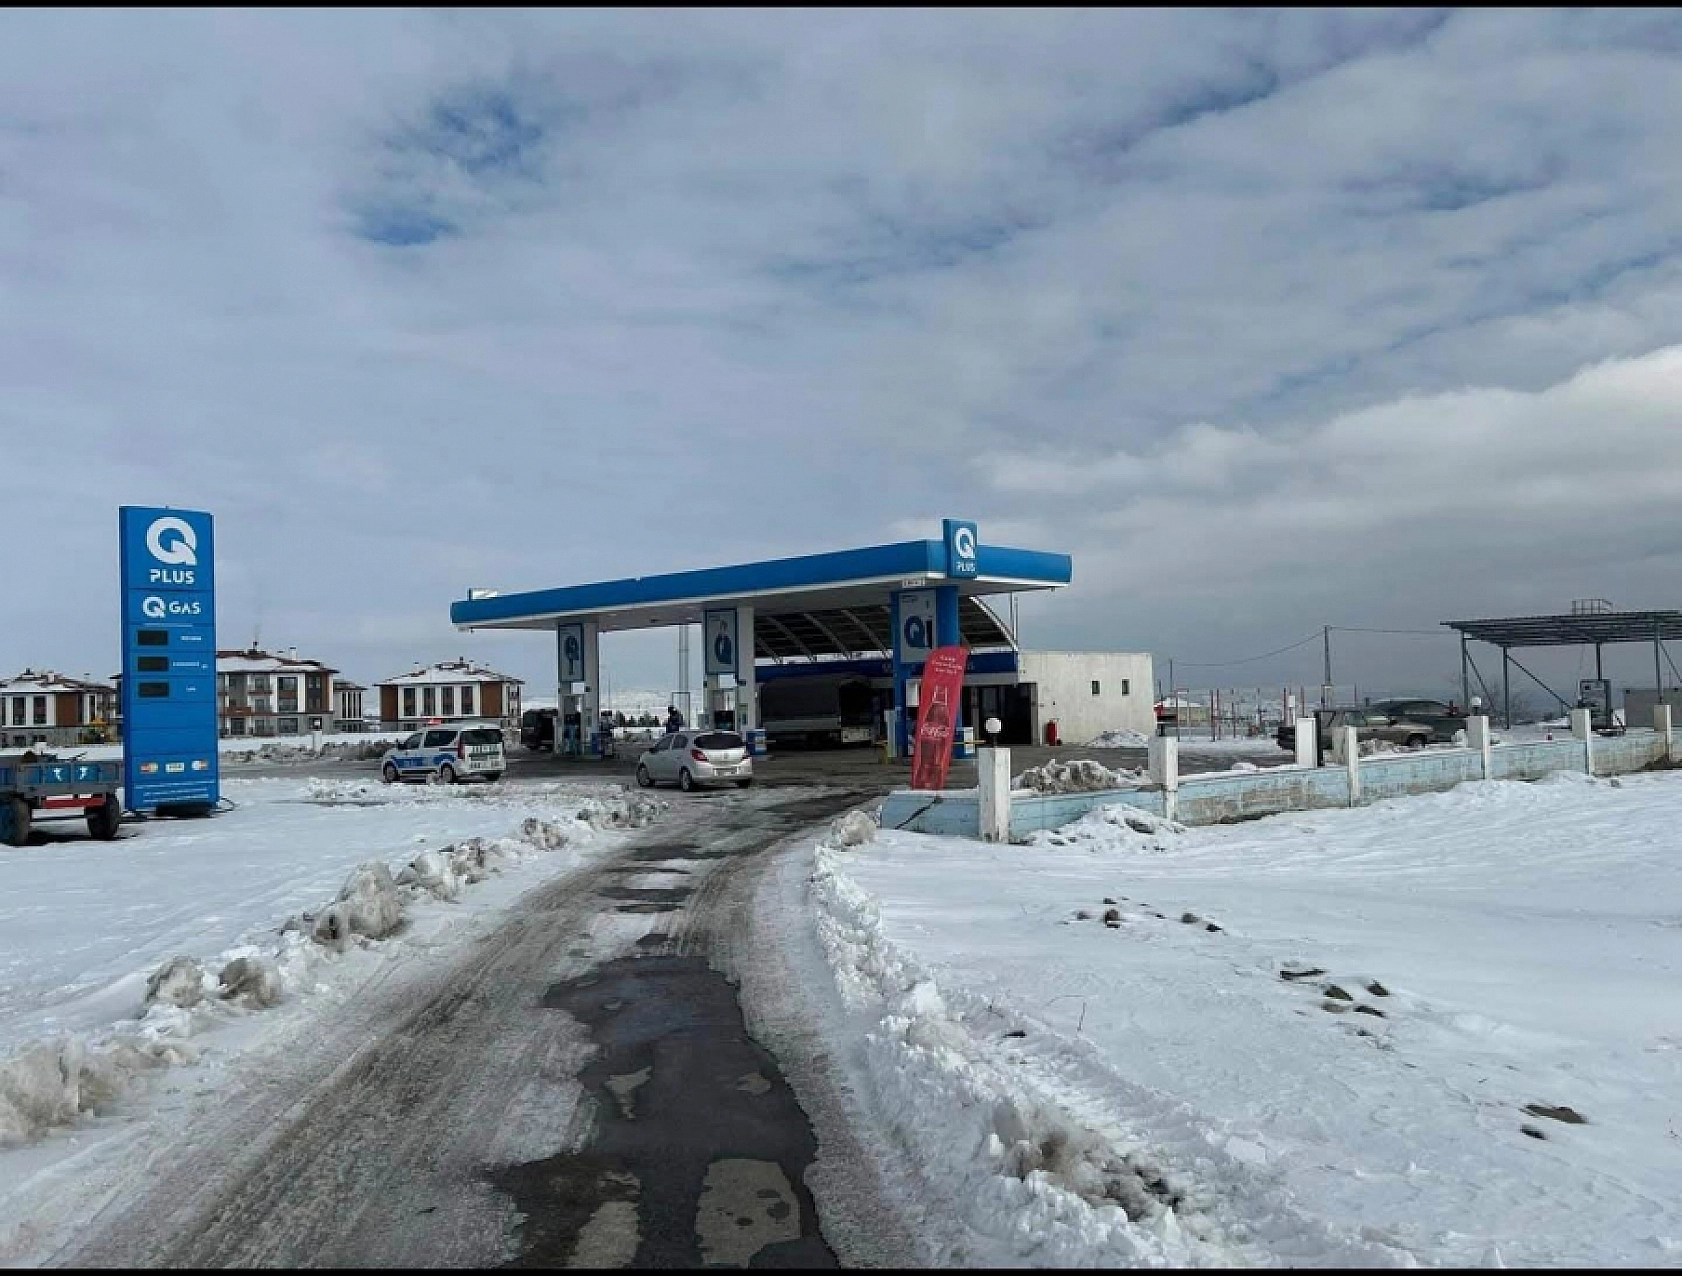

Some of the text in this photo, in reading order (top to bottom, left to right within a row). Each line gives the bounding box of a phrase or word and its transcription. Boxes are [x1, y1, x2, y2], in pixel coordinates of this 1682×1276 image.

[146, 516, 197, 566] Q
[954, 527, 976, 559] Q
[149, 568, 195, 585] PLUS
[956, 561, 976, 572] PLUS
[142, 596, 202, 618] Q GAS
